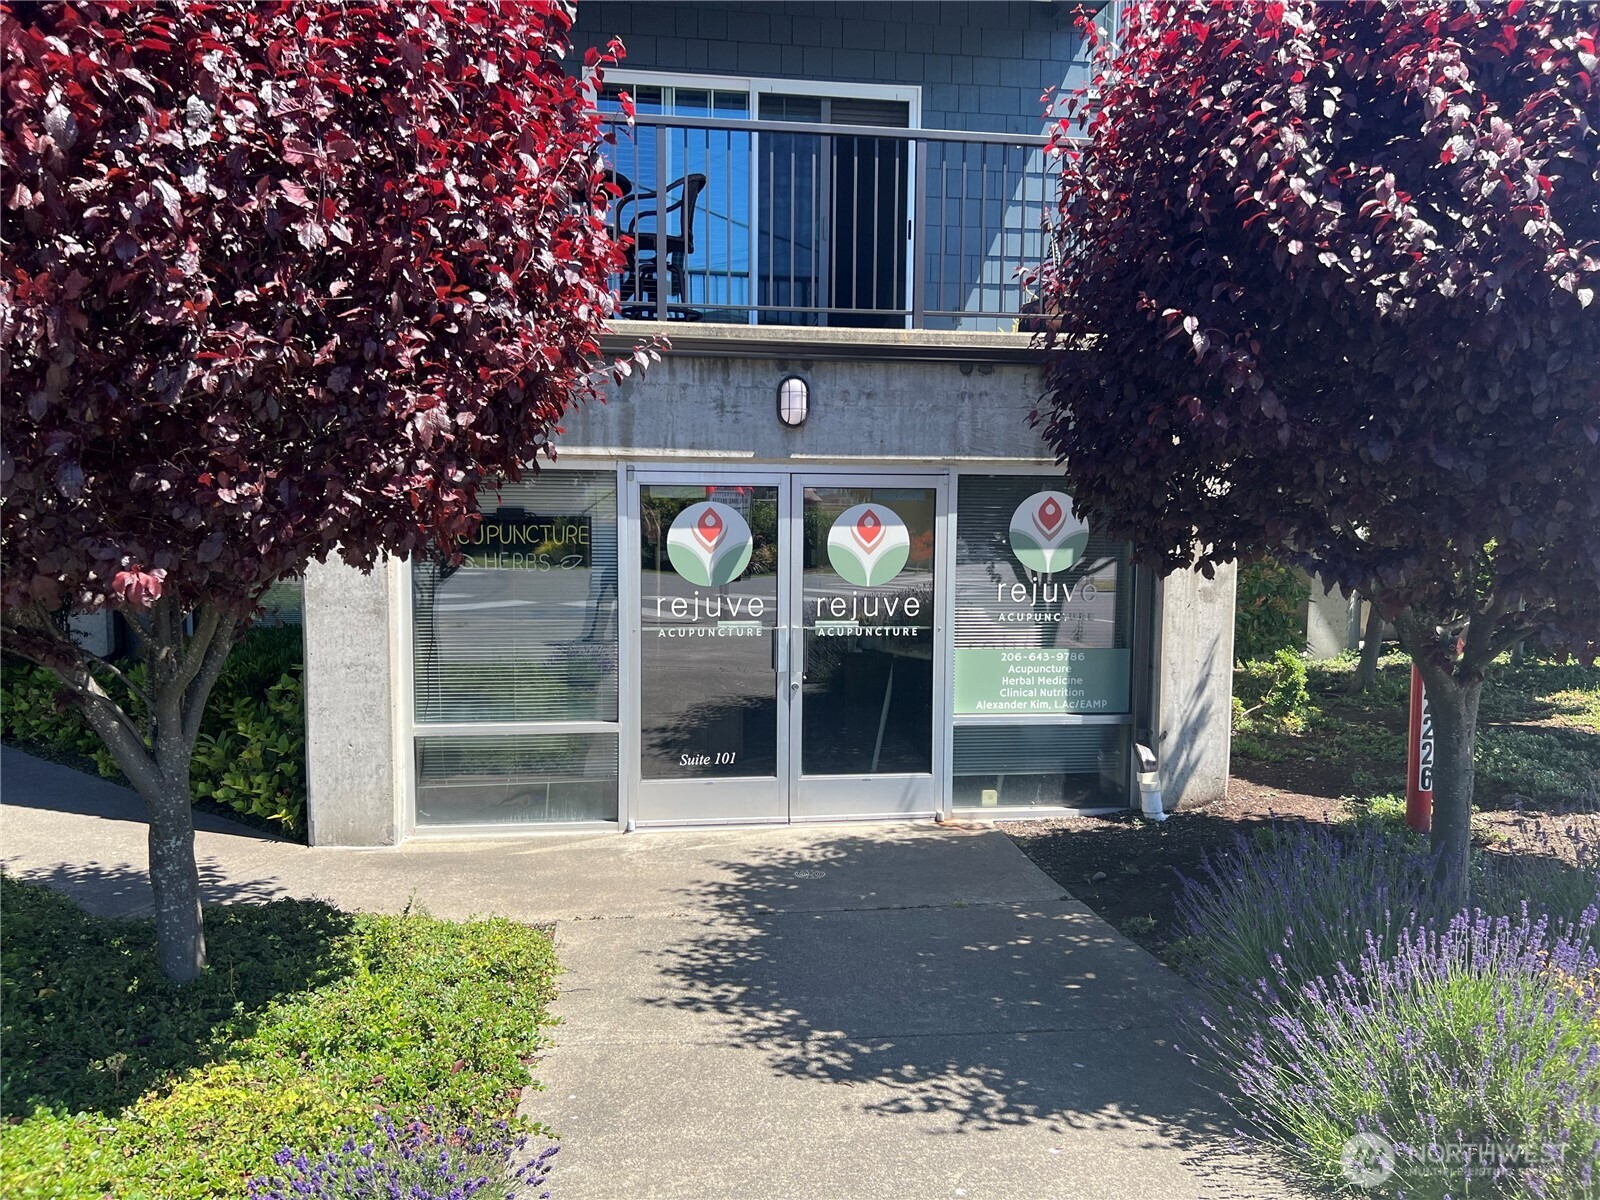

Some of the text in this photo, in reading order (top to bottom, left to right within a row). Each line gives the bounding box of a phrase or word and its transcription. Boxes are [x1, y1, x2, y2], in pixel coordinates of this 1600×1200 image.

[448, 524, 590, 545] CUPUNCTURE
[484, 552, 551, 572] HERBS
[997, 576, 1097, 607] rejuve
[657, 590, 764, 622] rejuve
[816, 590, 920, 621] rejuve
[658, 627, 763, 638] ACUPUNCTURE
[817, 626, 918, 637] ACUPUNCTURE
[1000, 652, 1085, 662] 206-643-9786
[1008, 664, 1072, 675] Acupuncture
[1002, 676, 1083, 686] Herbal Medicine
[1000, 688, 1085, 698] Clinical Nutrition
[976, 699, 1108, 710] Alexander Kim, L.Ac/EAMP
[679, 751, 736, 767] Suite 101
